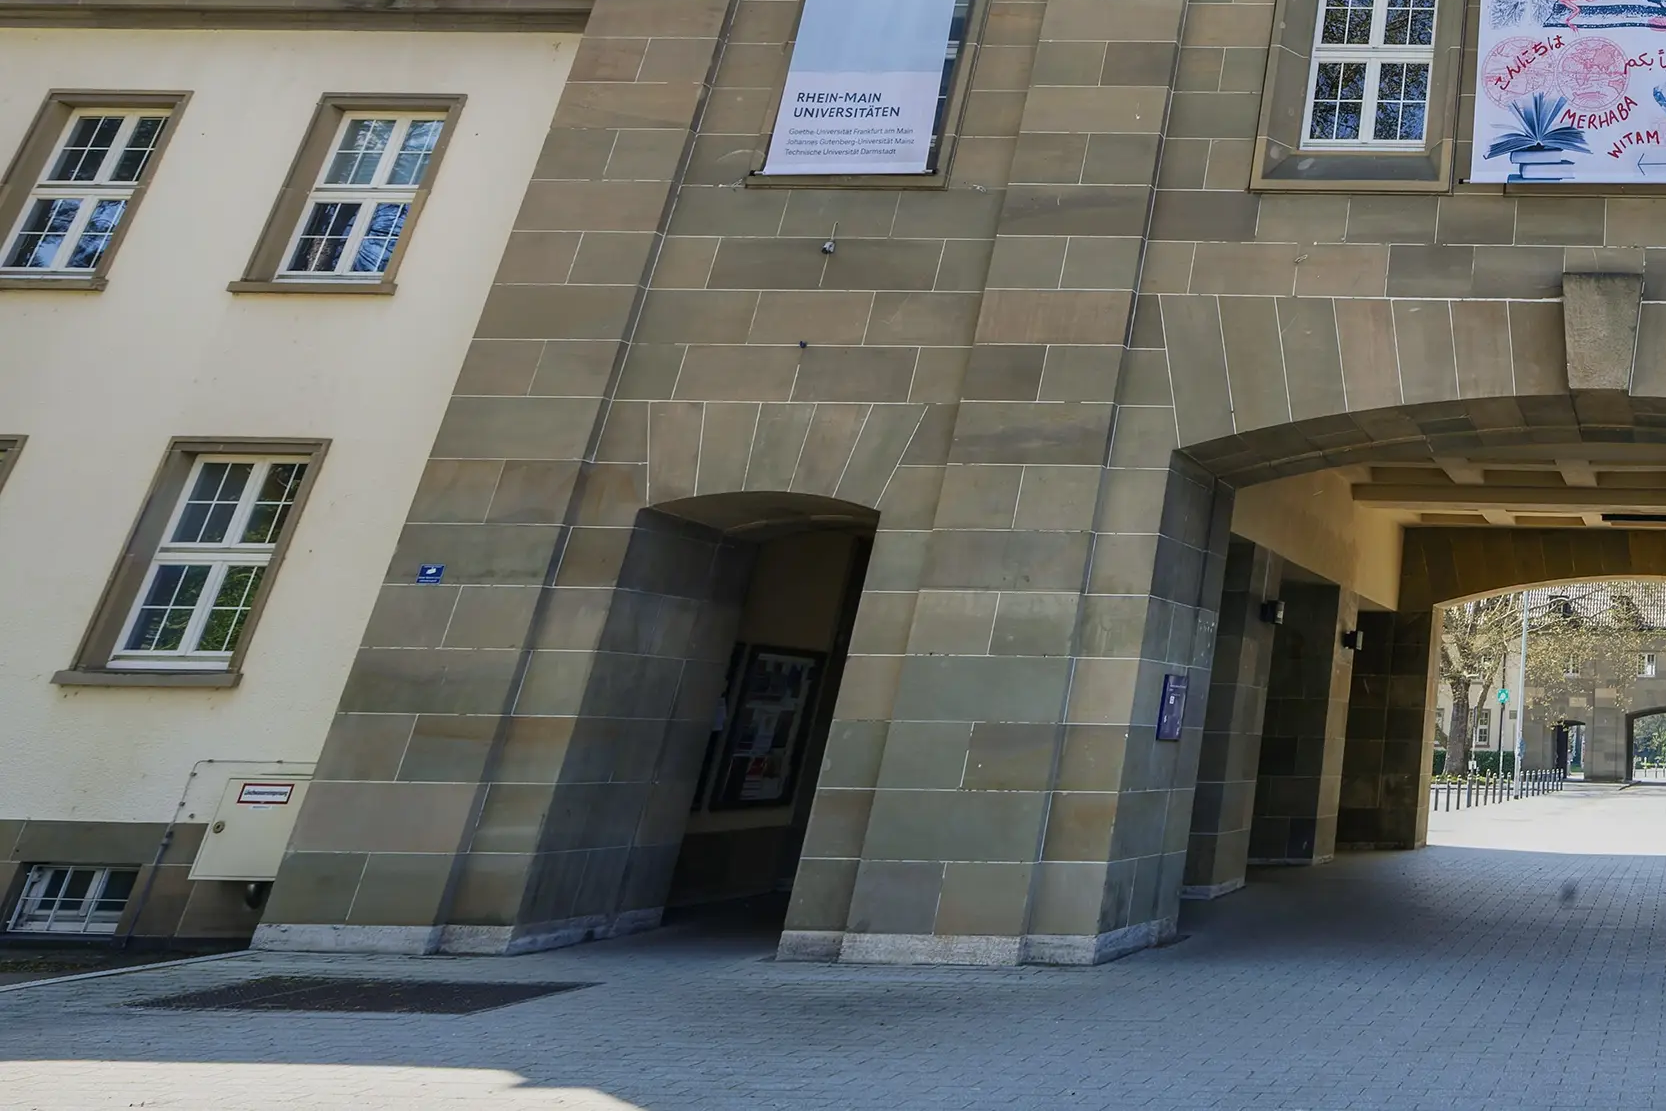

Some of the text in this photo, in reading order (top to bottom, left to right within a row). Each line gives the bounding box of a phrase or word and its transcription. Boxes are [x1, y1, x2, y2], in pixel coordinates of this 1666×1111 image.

[1494, 34, 1565, 90] こんにちは
[796, 92, 882, 103] RHEIN-MAIN
[793, 104, 901, 118] UNIVERSITÄTEN
[1560, 96, 1638, 129] MERHABA
[896, 127, 914, 135] Main
[894, 137, 915, 145] Mainz
[1608, 130, 1660, 159] WITAM
[860, 146, 896, 156] Darmstadt
